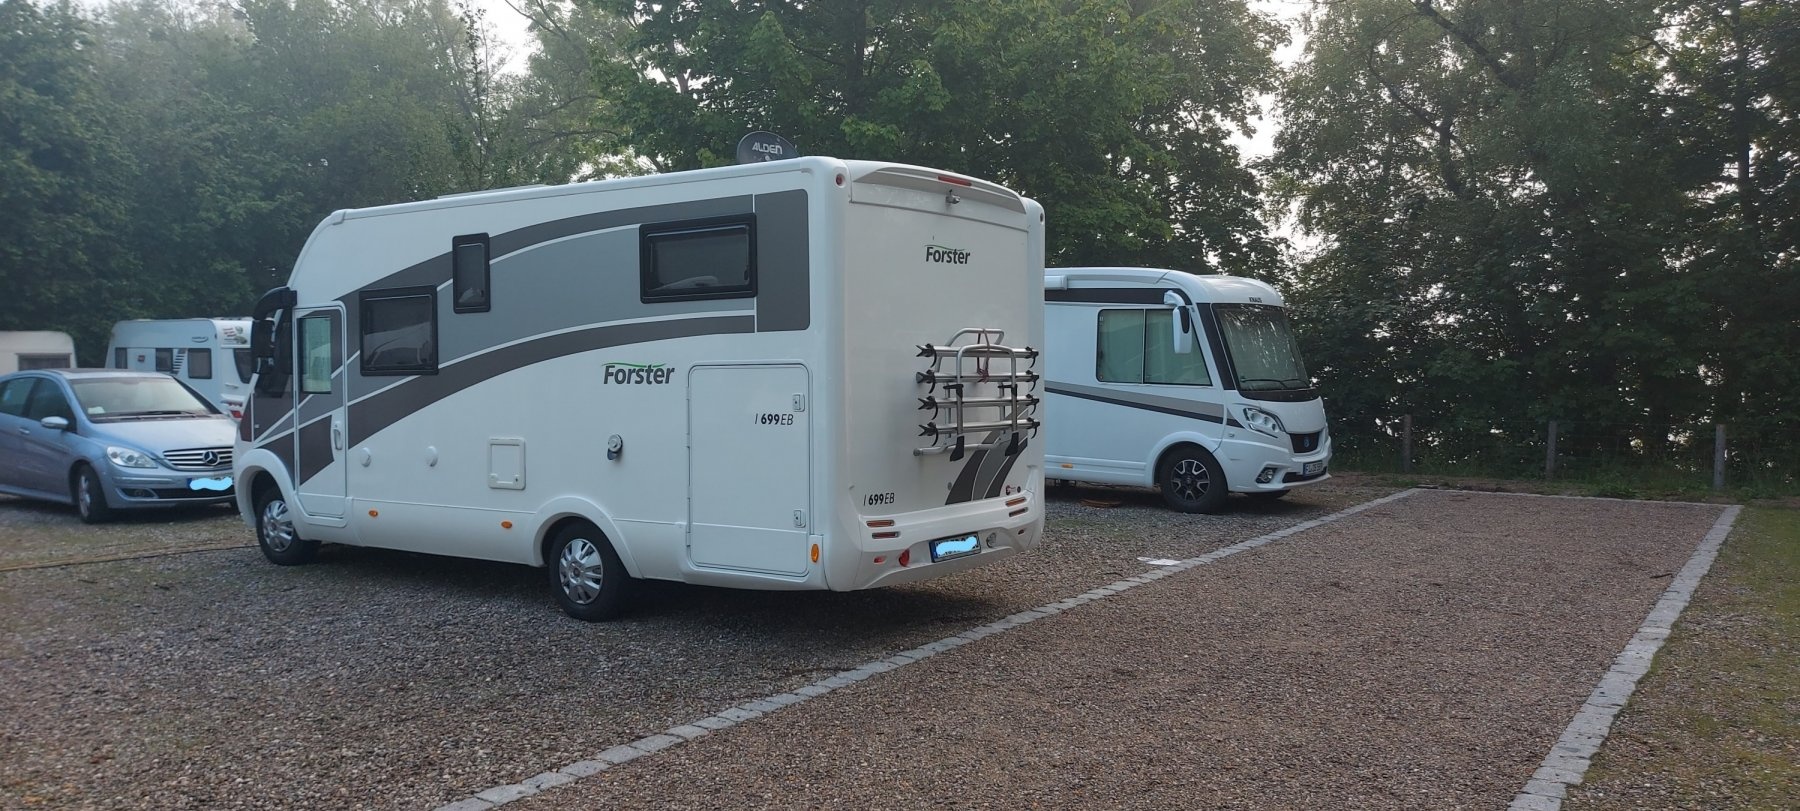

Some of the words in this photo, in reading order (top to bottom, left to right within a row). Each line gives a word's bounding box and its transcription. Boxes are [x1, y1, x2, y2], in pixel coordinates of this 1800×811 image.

[752, 141, 783, 155] ALDEN
[925, 246, 971, 265] Forster
[603, 364, 675, 385] Forster
